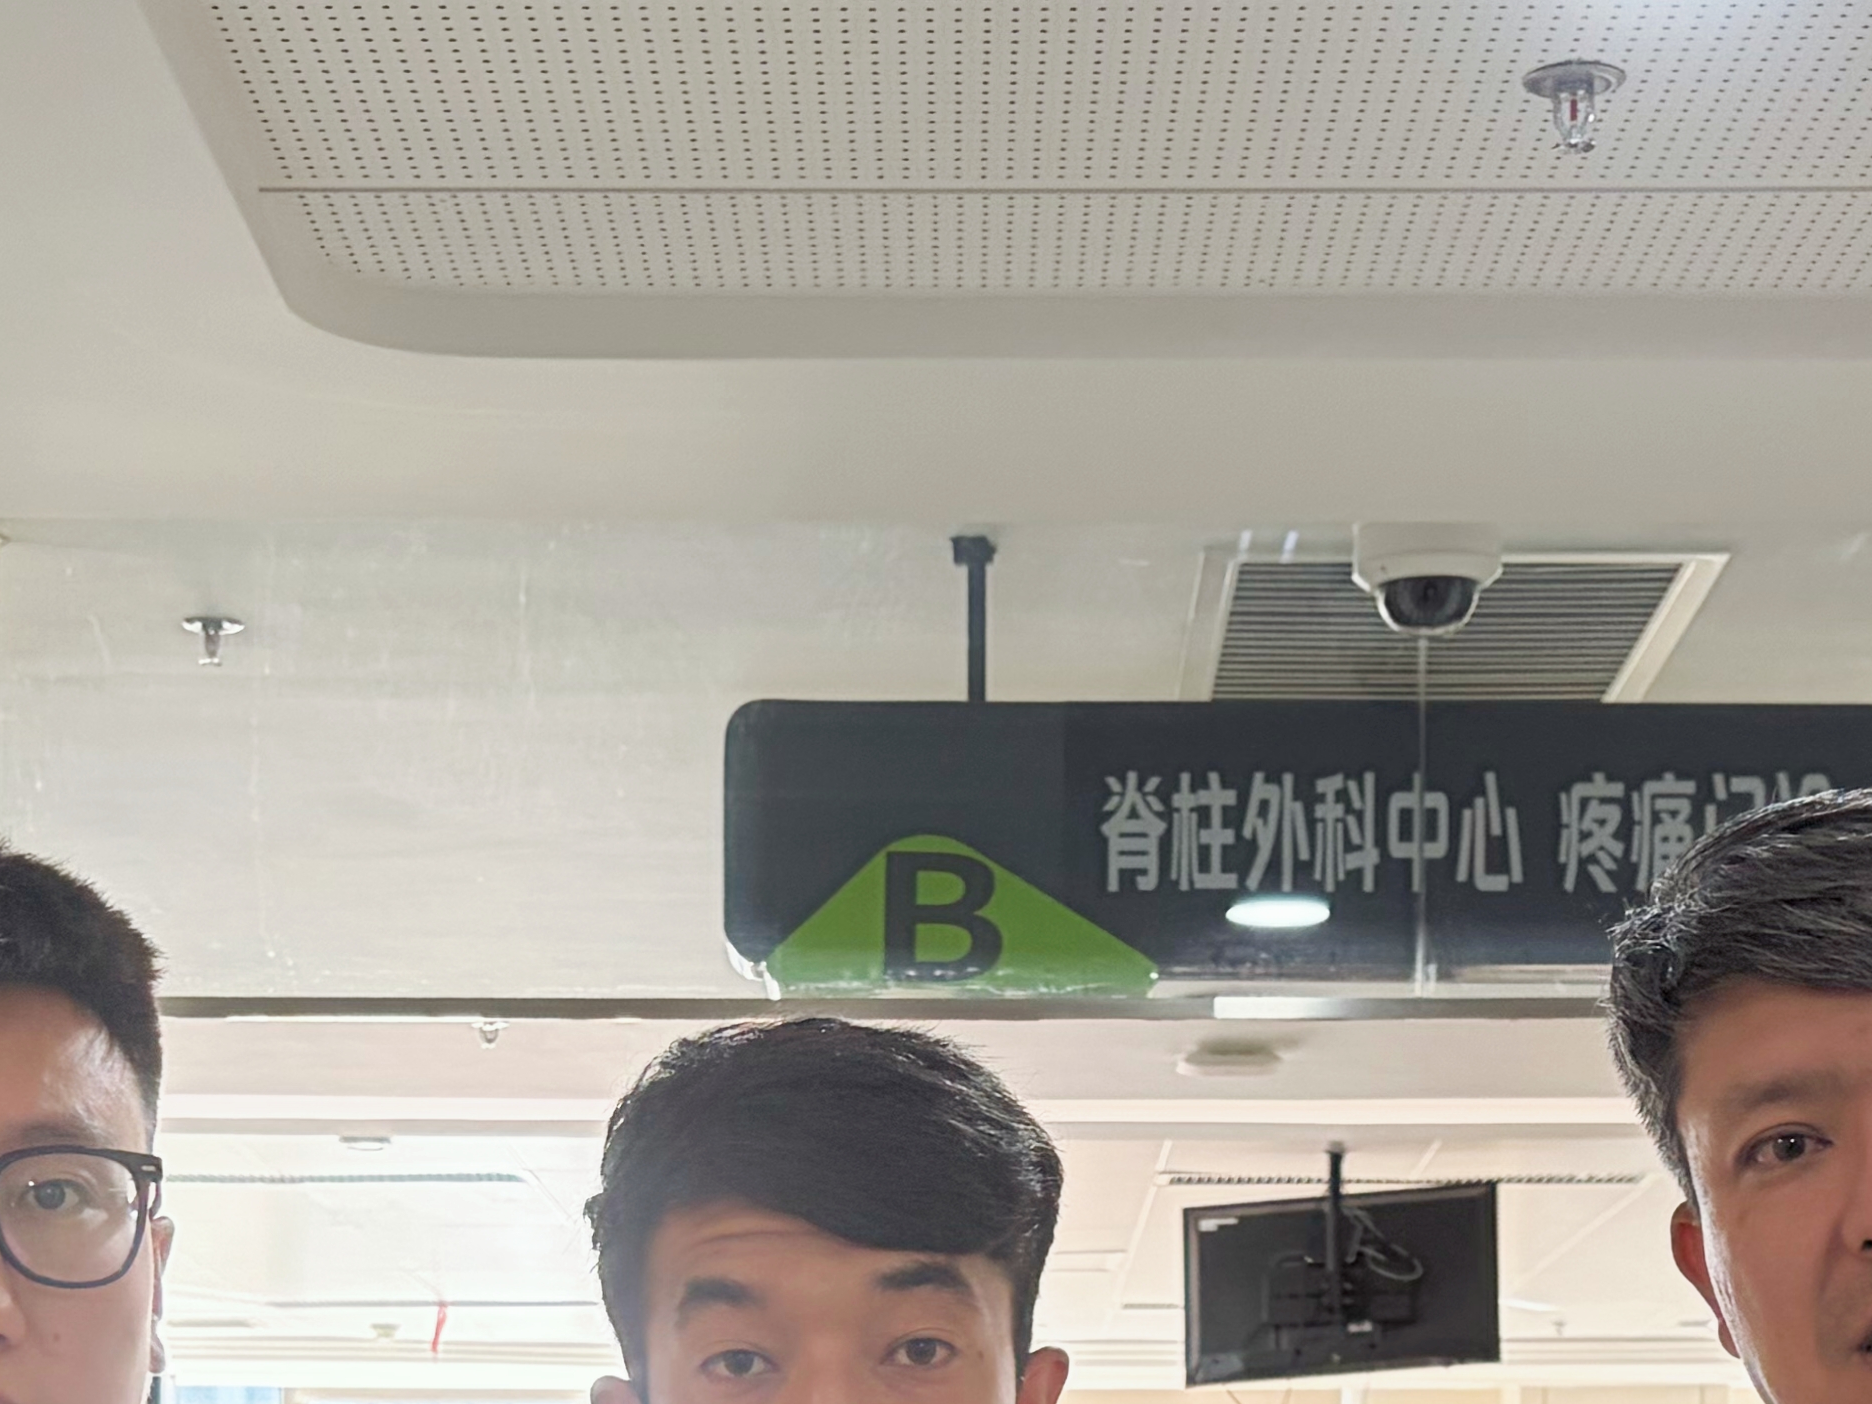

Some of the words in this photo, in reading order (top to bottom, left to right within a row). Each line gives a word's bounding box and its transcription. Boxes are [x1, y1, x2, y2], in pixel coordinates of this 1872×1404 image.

[1100, 771, 1524, 892] 脊柱外科中心
[883, 851, 1003, 982] B
